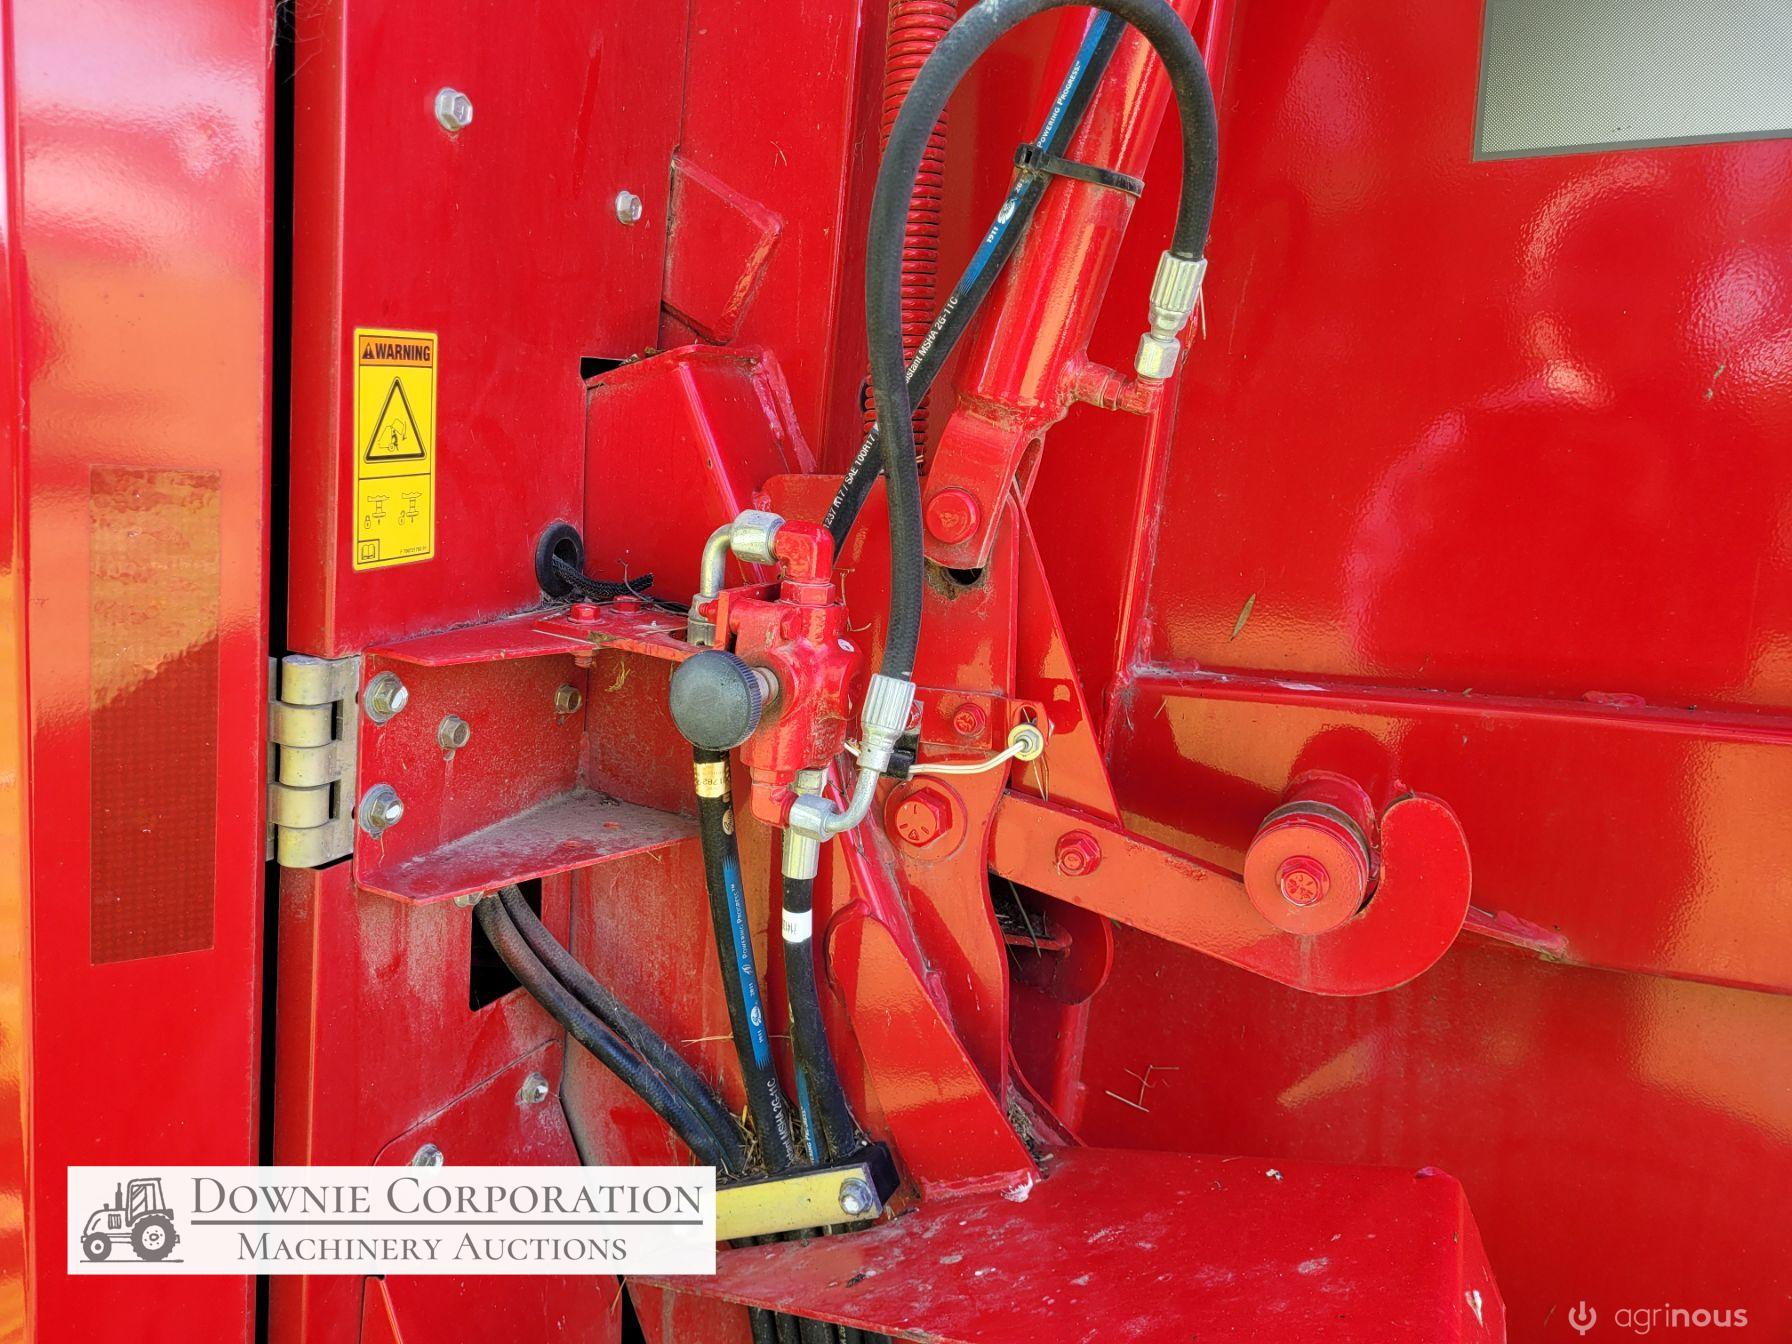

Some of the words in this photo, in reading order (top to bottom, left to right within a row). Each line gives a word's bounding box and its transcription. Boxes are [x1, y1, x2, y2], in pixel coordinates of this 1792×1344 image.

[375, 342, 431, 362] WARNING
[917, 329, 939, 357] MSHA
[933, 295, 958, 330] 2G-11C
[844, 466, 859, 485] SAE
[854, 433, 876, 466] 100R17
